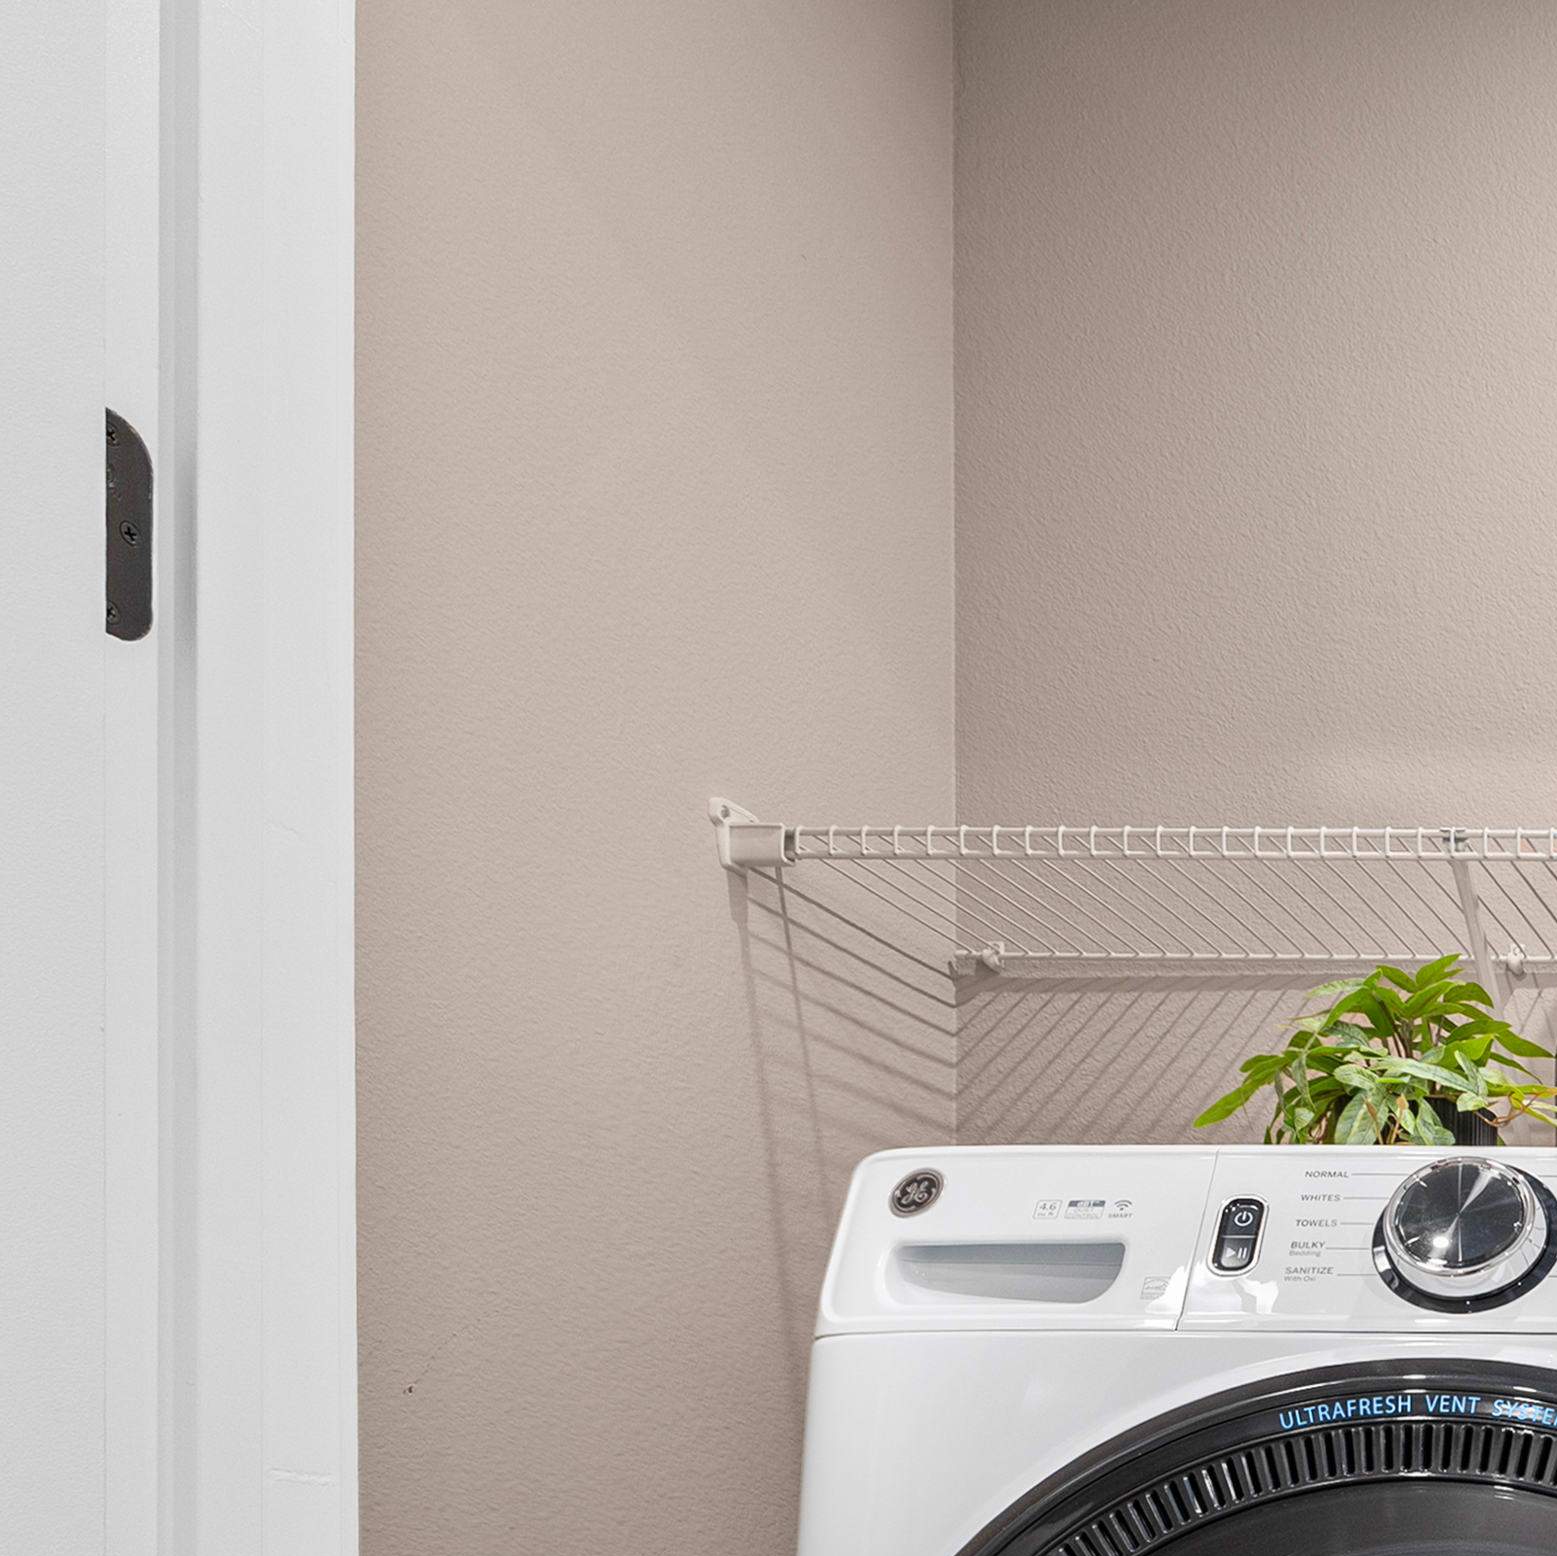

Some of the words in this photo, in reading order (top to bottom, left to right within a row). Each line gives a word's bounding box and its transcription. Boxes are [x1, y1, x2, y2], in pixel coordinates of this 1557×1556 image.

[1305, 1170, 1349, 1178] NORMAL
[1300, 1194, 1341, 1202] WHITES
[1296, 1219, 1338, 1227] TOWELS
[1291, 1241, 1325, 1249] BULKY
[1285, 1267, 1334, 1275] SANITIZE
[1280, 1395, 1412, 1430] ULTRAFRESH
[1425, 1395, 1481, 1414] VENT
